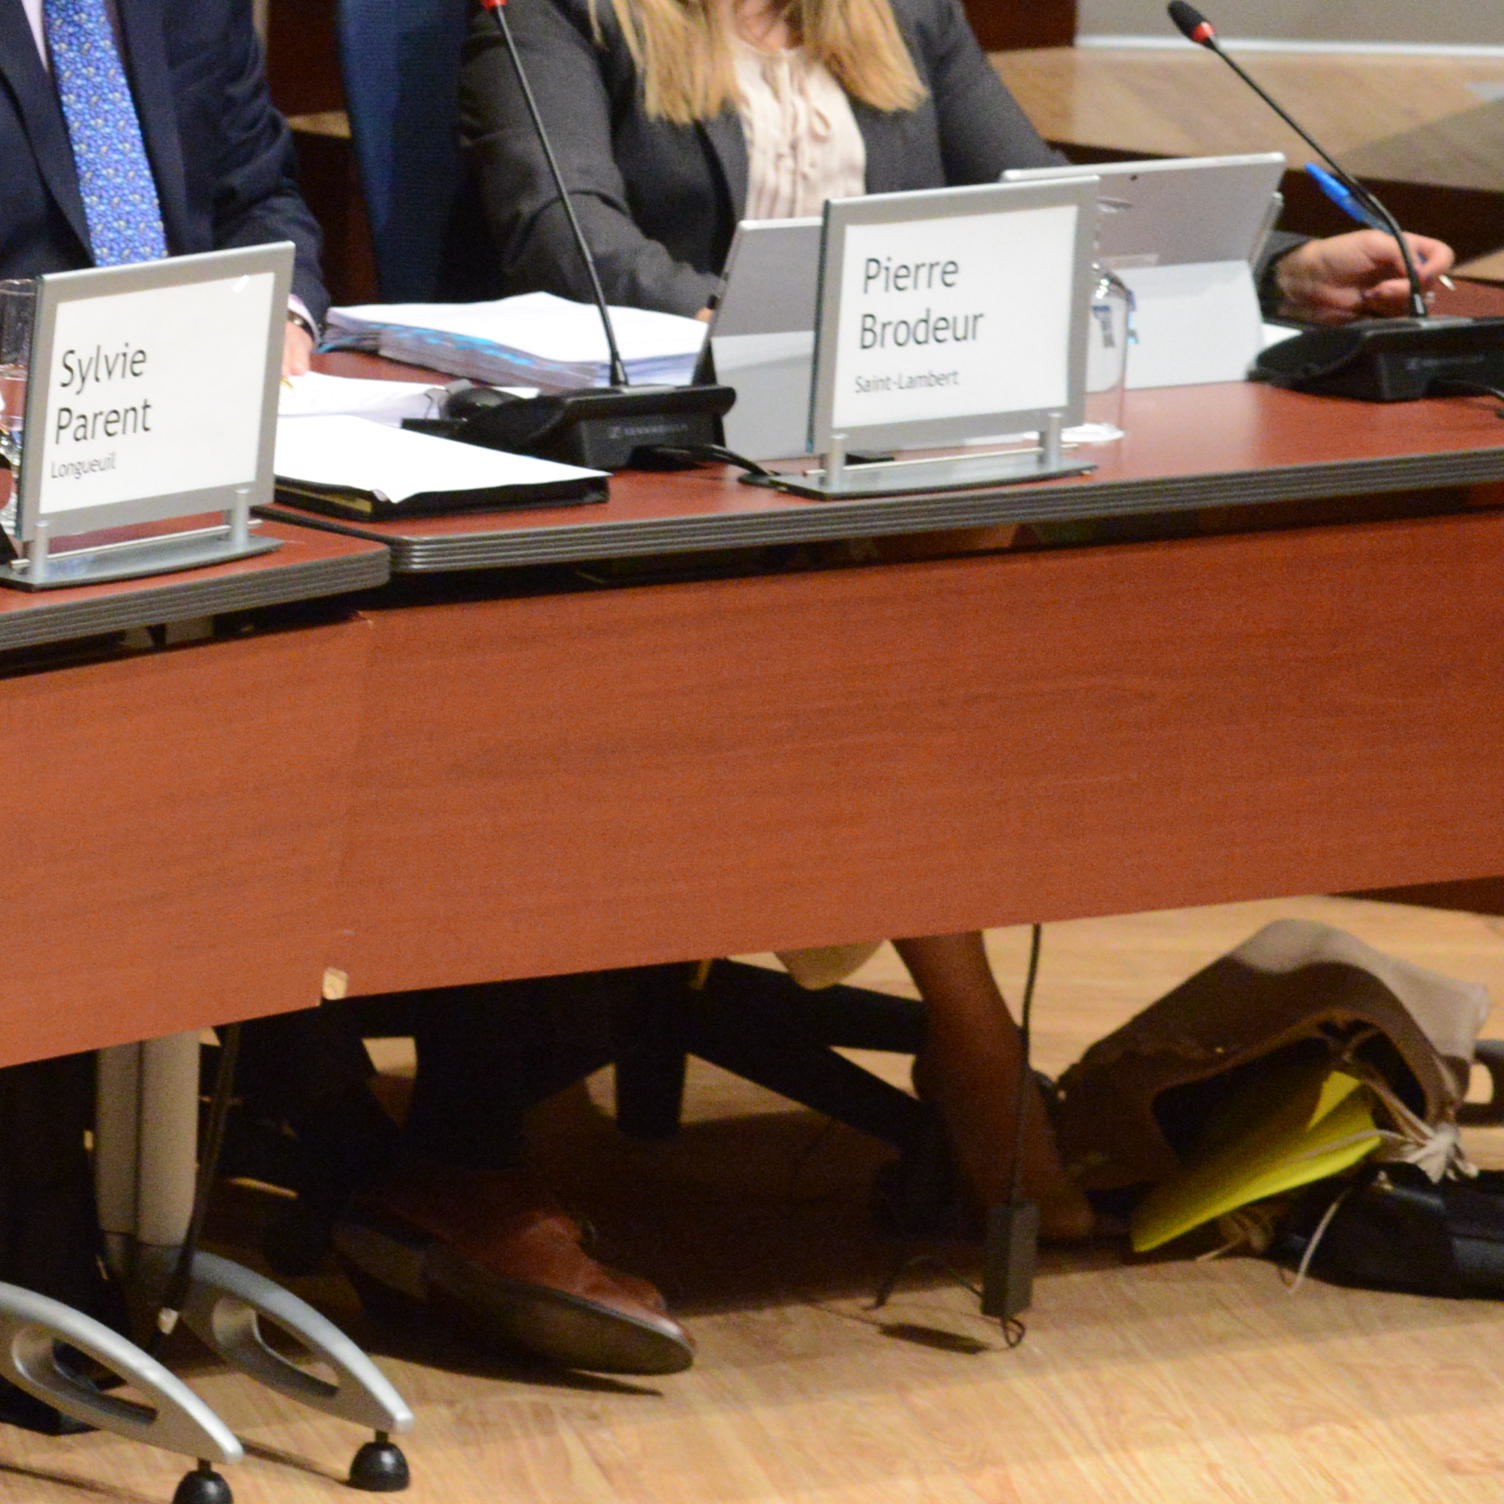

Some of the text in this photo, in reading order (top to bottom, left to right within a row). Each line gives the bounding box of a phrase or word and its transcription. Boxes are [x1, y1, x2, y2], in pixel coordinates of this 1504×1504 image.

[863, 257, 960, 295] Pierre
[859, 308, 985, 350] Brodeur
[59, 342, 148, 395] Sylvie
[854, 369, 960, 394] Saint-Lambert
[55, 398, 152, 445] Parent
[50, 452, 117, 479] Longueuil
